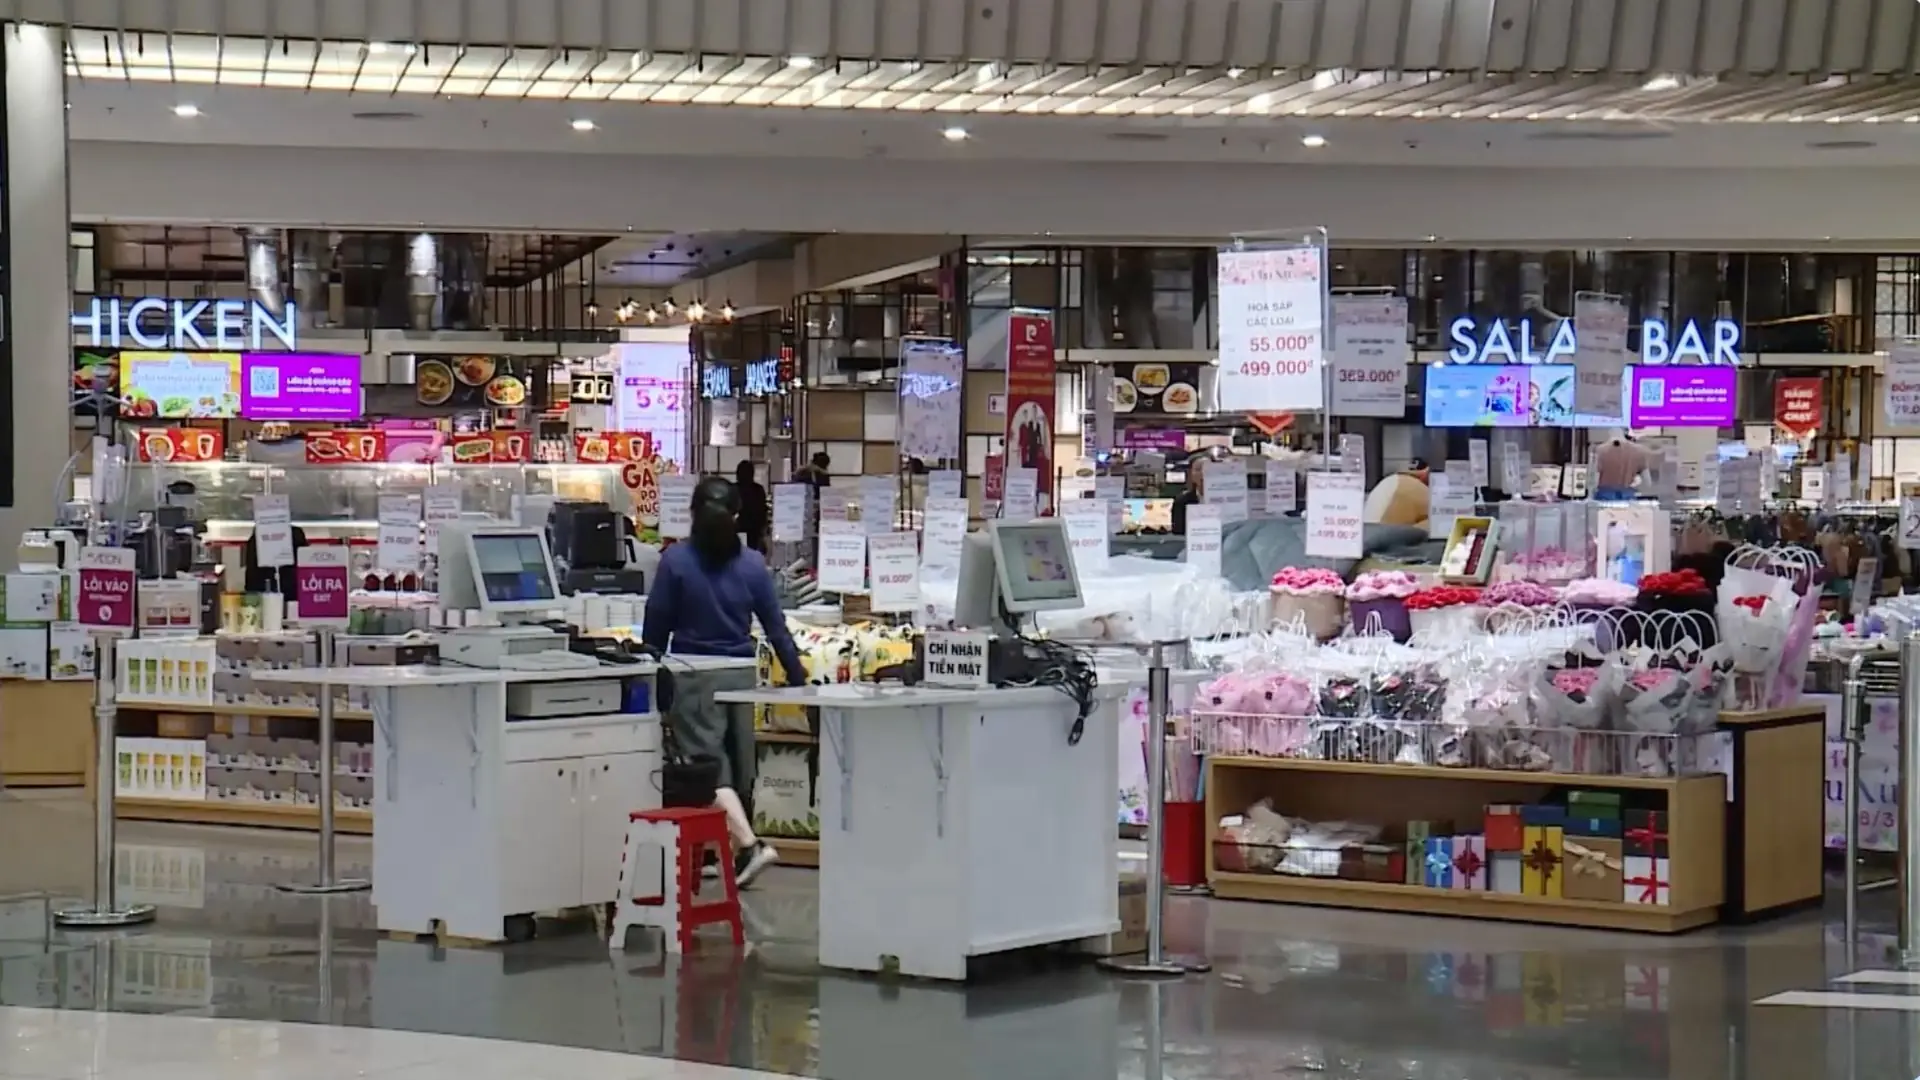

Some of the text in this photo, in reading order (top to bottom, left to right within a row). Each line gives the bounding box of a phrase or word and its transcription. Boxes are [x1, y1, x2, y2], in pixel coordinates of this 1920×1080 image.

[1247, 302, 1269, 311] HOA
[72, 298, 295, 350] HICKEN
[1643, 318, 1740, 364] BAR
[326, 579, 343, 590] RA
